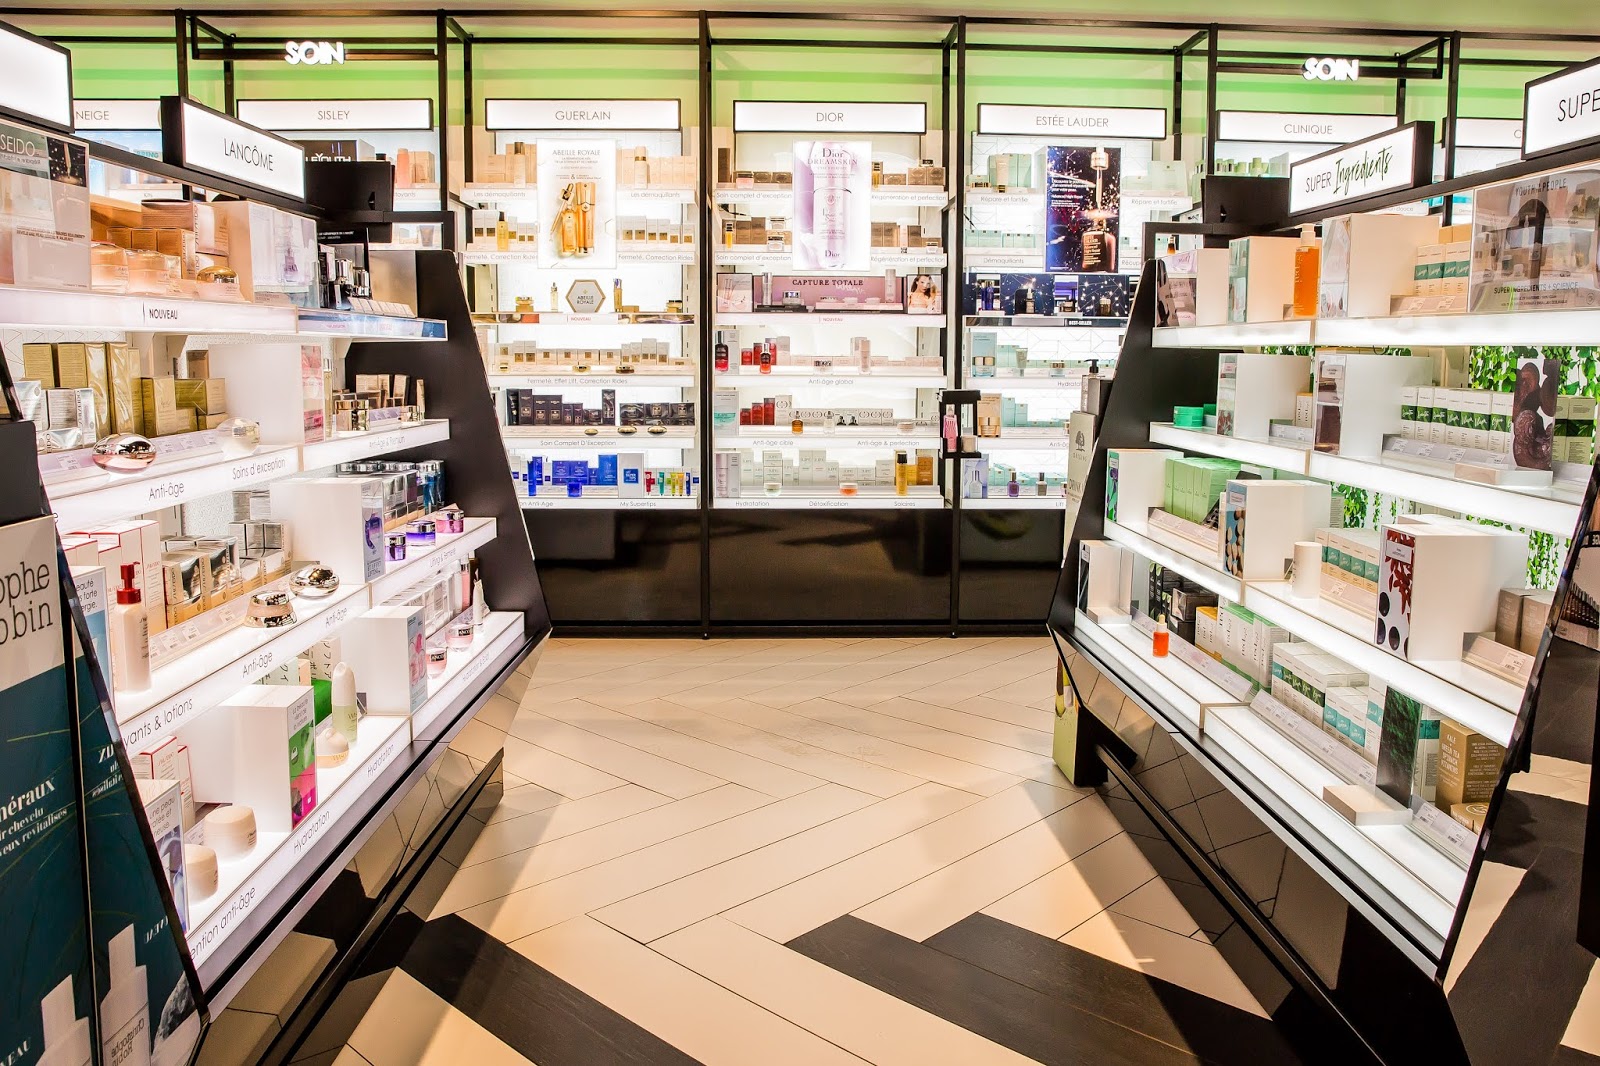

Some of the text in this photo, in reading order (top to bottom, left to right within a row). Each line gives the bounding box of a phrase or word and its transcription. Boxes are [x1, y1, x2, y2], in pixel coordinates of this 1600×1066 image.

[284, 41, 348, 66] SOIN
[1302, 57, 1359, 81] SOIN
[76, 110, 110, 121] NEIGE
[317, 110, 350, 121] SISLEY
[555, 110, 611, 121] GUERLAIN
[816, 112, 844, 122] DIOR
[1036, 114, 1109, 128] ESTÉE LAUDER
[1284, 124, 1333, 135] CLINIQUE
[224, 138, 274, 172] LANCÔME
[822, 148, 844, 158] Dior
[1305, 145, 1394, 195] SUPER Ingrédients
[484, 191, 526, 199] démaquillants
[641, 191, 681, 199] démaquillants
[730, 192, 754, 200] complet
[677, 254, 694, 262] Rides
[729, 254, 754, 262] complet
[825, 249, 840, 258] Dior
[150, 309, 178, 320] NOUVEAU
[808, 378, 854, 386] Anti-âge global
[232, 458, 286, 480] Soins d'exception
[149, 481, 185, 501] Anti-âge
[735, 500, 770, 508] Hydratation
[325, 607, 348, 628] Anti-âge
[243, 652, 273, 678] Anti-âge
[154, 715, 162, 730] &
[163, 697, 193, 724] lotions
[367, 743, 394, 777] Hydratation
[8, 807, 44, 835] chevelu
[22, 808, 68, 843] revitalisés
[293, 809, 330, 853] Hydratation
[220, 886, 256, 929] anti-âge
